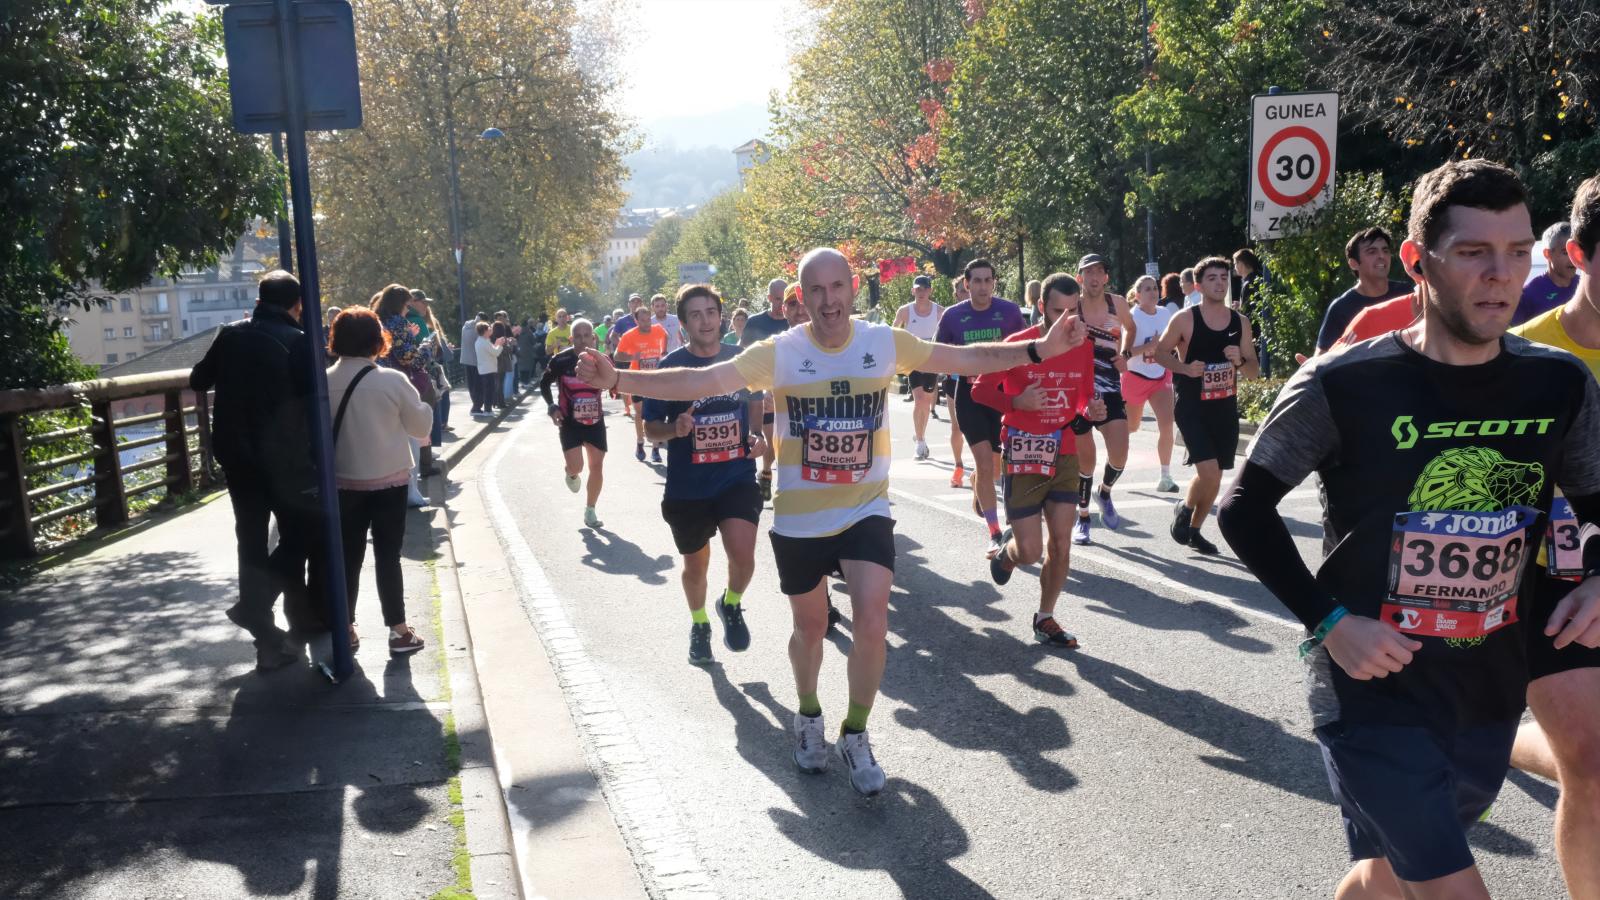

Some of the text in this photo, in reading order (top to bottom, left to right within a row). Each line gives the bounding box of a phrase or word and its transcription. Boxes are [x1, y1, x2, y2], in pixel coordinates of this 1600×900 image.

[1265, 103, 1326, 120] GUNEA
[1276, 154, 1315, 181] 30
[830, 380, 851, 396] 59
[696, 422, 738, 441] 5391
[826, 420, 864, 431] Joma
[1423, 418, 1555, 439] SCOTT
[705, 440, 733, 448] IGNACIO
[810, 433, 868, 453] 3887
[1013, 438, 1056, 453] 5128
[820, 456, 857, 464] CHECHU
[1445, 510, 1518, 535] Joma
[1404, 537, 1523, 581] 3688
[1413, 580, 1506, 599] FERNANDO
